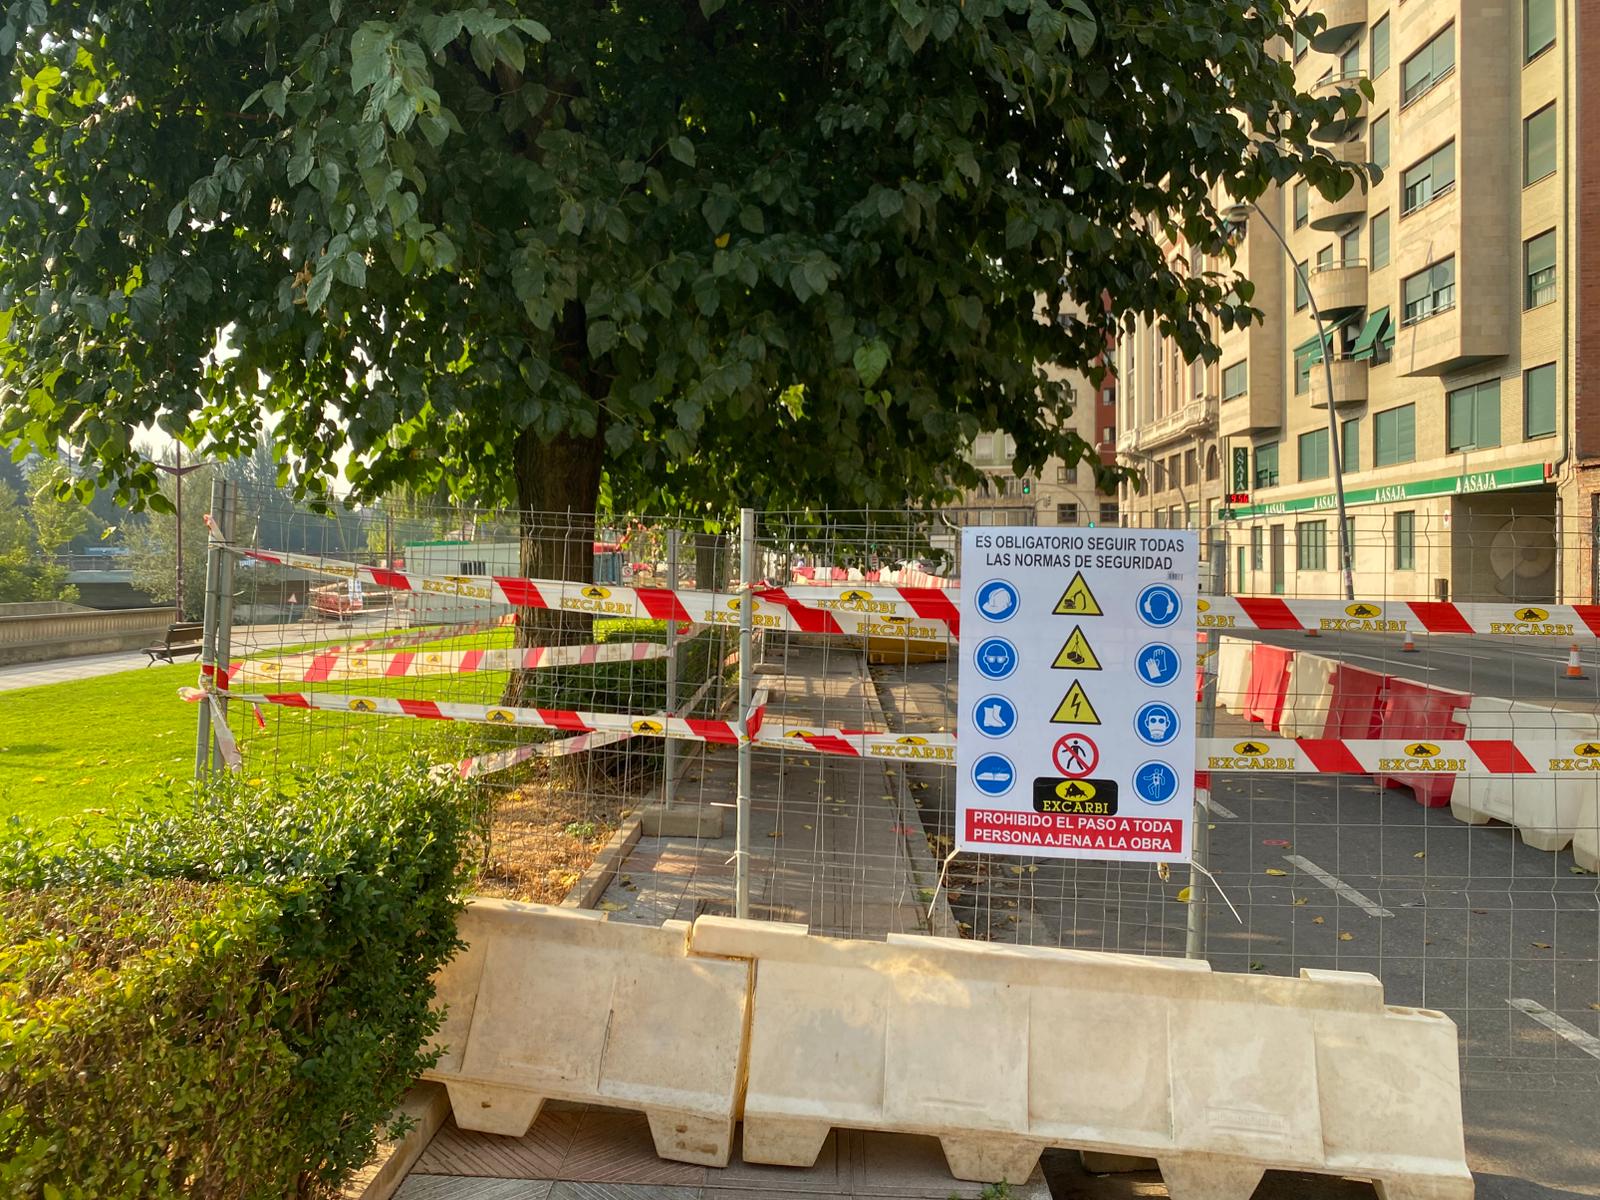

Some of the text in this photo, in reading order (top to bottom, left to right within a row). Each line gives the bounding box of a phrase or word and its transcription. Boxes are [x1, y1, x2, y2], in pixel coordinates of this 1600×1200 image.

[1236, 449, 1245, 490] ASAJA
[1463, 473, 1496, 492] ASAJA
[1381, 486, 1406, 502] ASAJA
[975, 536, 1185, 552] ES OBLIGATORIO SEGUIR TODAS
[986, 553, 1173, 570] LAS NORMAS DE SEGURIDAD
[559, 597, 633, 615] EXCARBI
[817, 599, 897, 614] EXCARBI
[704, 610, 782, 627] EXCRBI
[1320, 618, 1408, 632] EXCARBI
[856, 622, 937, 640] EXCARBI
[1490, 623, 1575, 636] EXCARBI
[871, 744, 955, 760] EXCARBI
[1208, 756, 1295, 770] EXCARBI
[1379, 758, 1467, 771] EXCARBI
[1042, 800, 1109, 814] EXCARBI
[973, 812, 1173, 833] PROHIBIDO EL PASO A TODA
[973, 829, 1172, 851] PERSONA AJENA A LA OBRA
